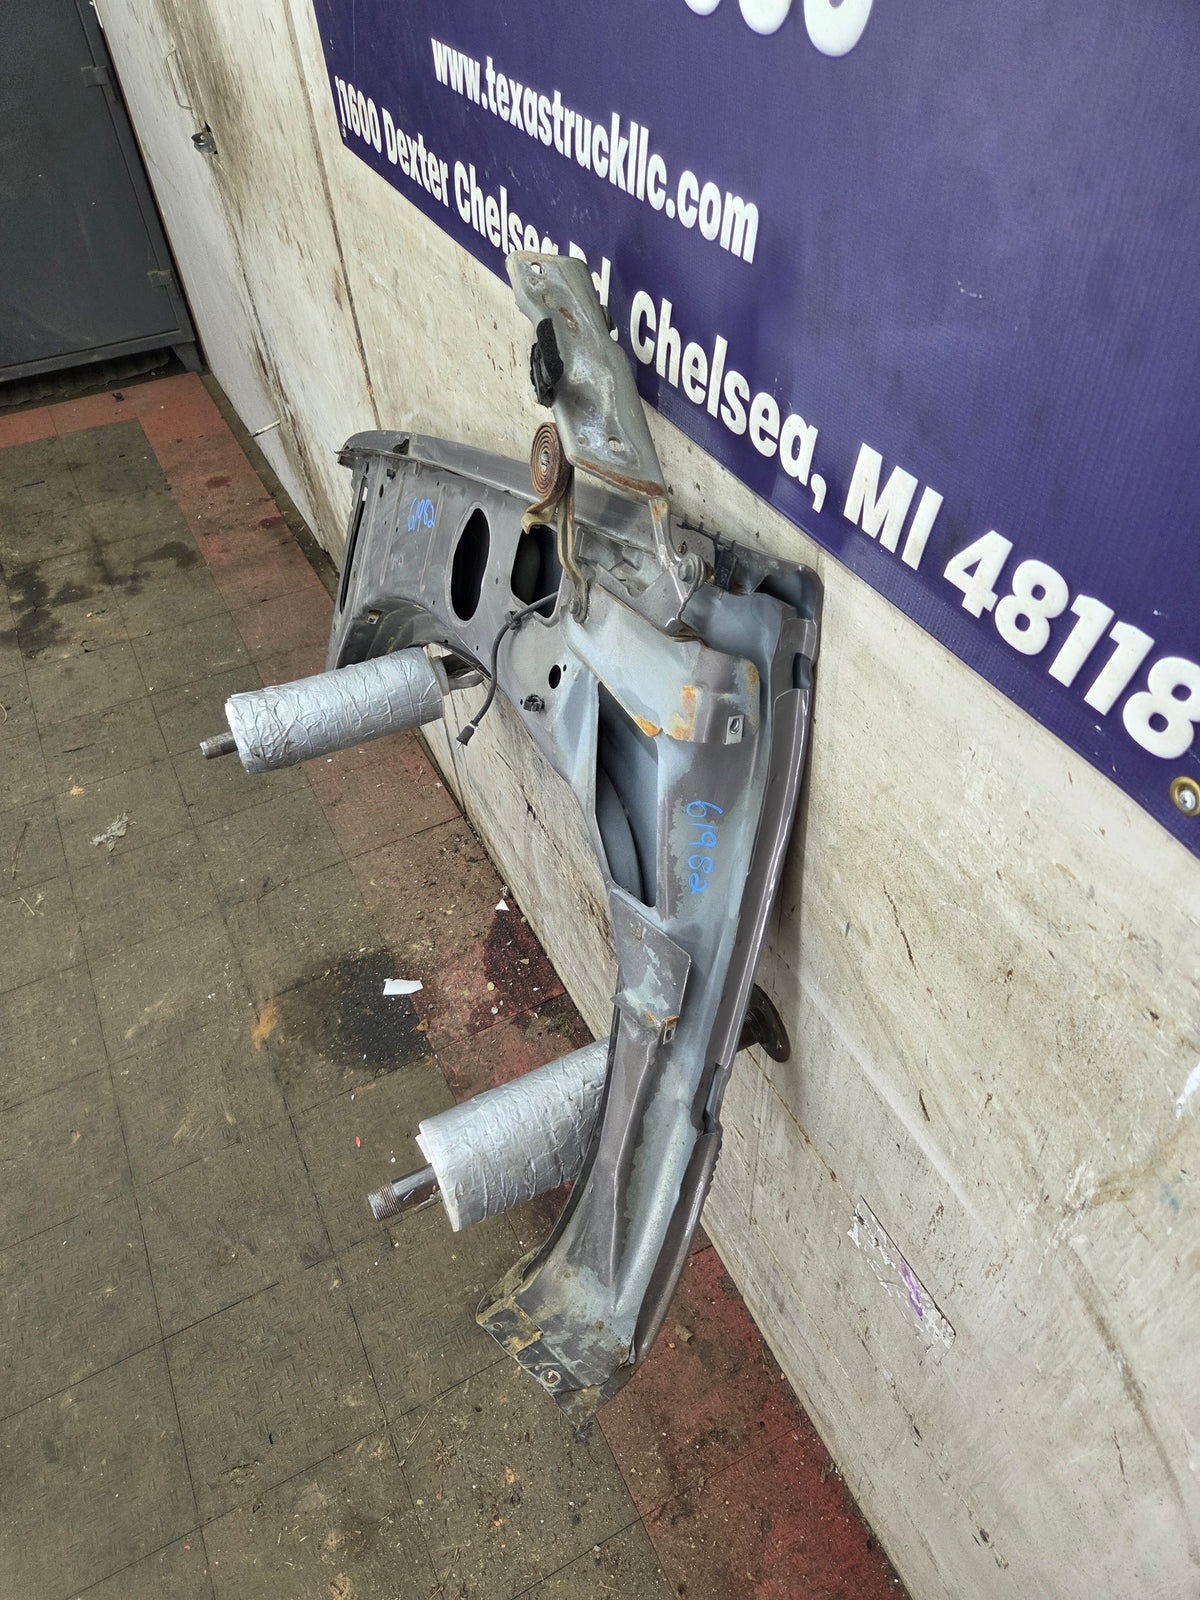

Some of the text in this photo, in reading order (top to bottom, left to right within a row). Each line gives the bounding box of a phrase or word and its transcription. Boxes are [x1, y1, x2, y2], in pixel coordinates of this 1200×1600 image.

[431, 38, 760, 264] www.texastruckllc.com
[335, 75, 382, 153] 11600
[382, 107, 449, 208] Dexter
[630, 290, 826, 513] Chelsea,
[843, 442, 944, 570] MI
[943, 530, 1200, 759] 48118
[686, 800, 723, 895] 61982
